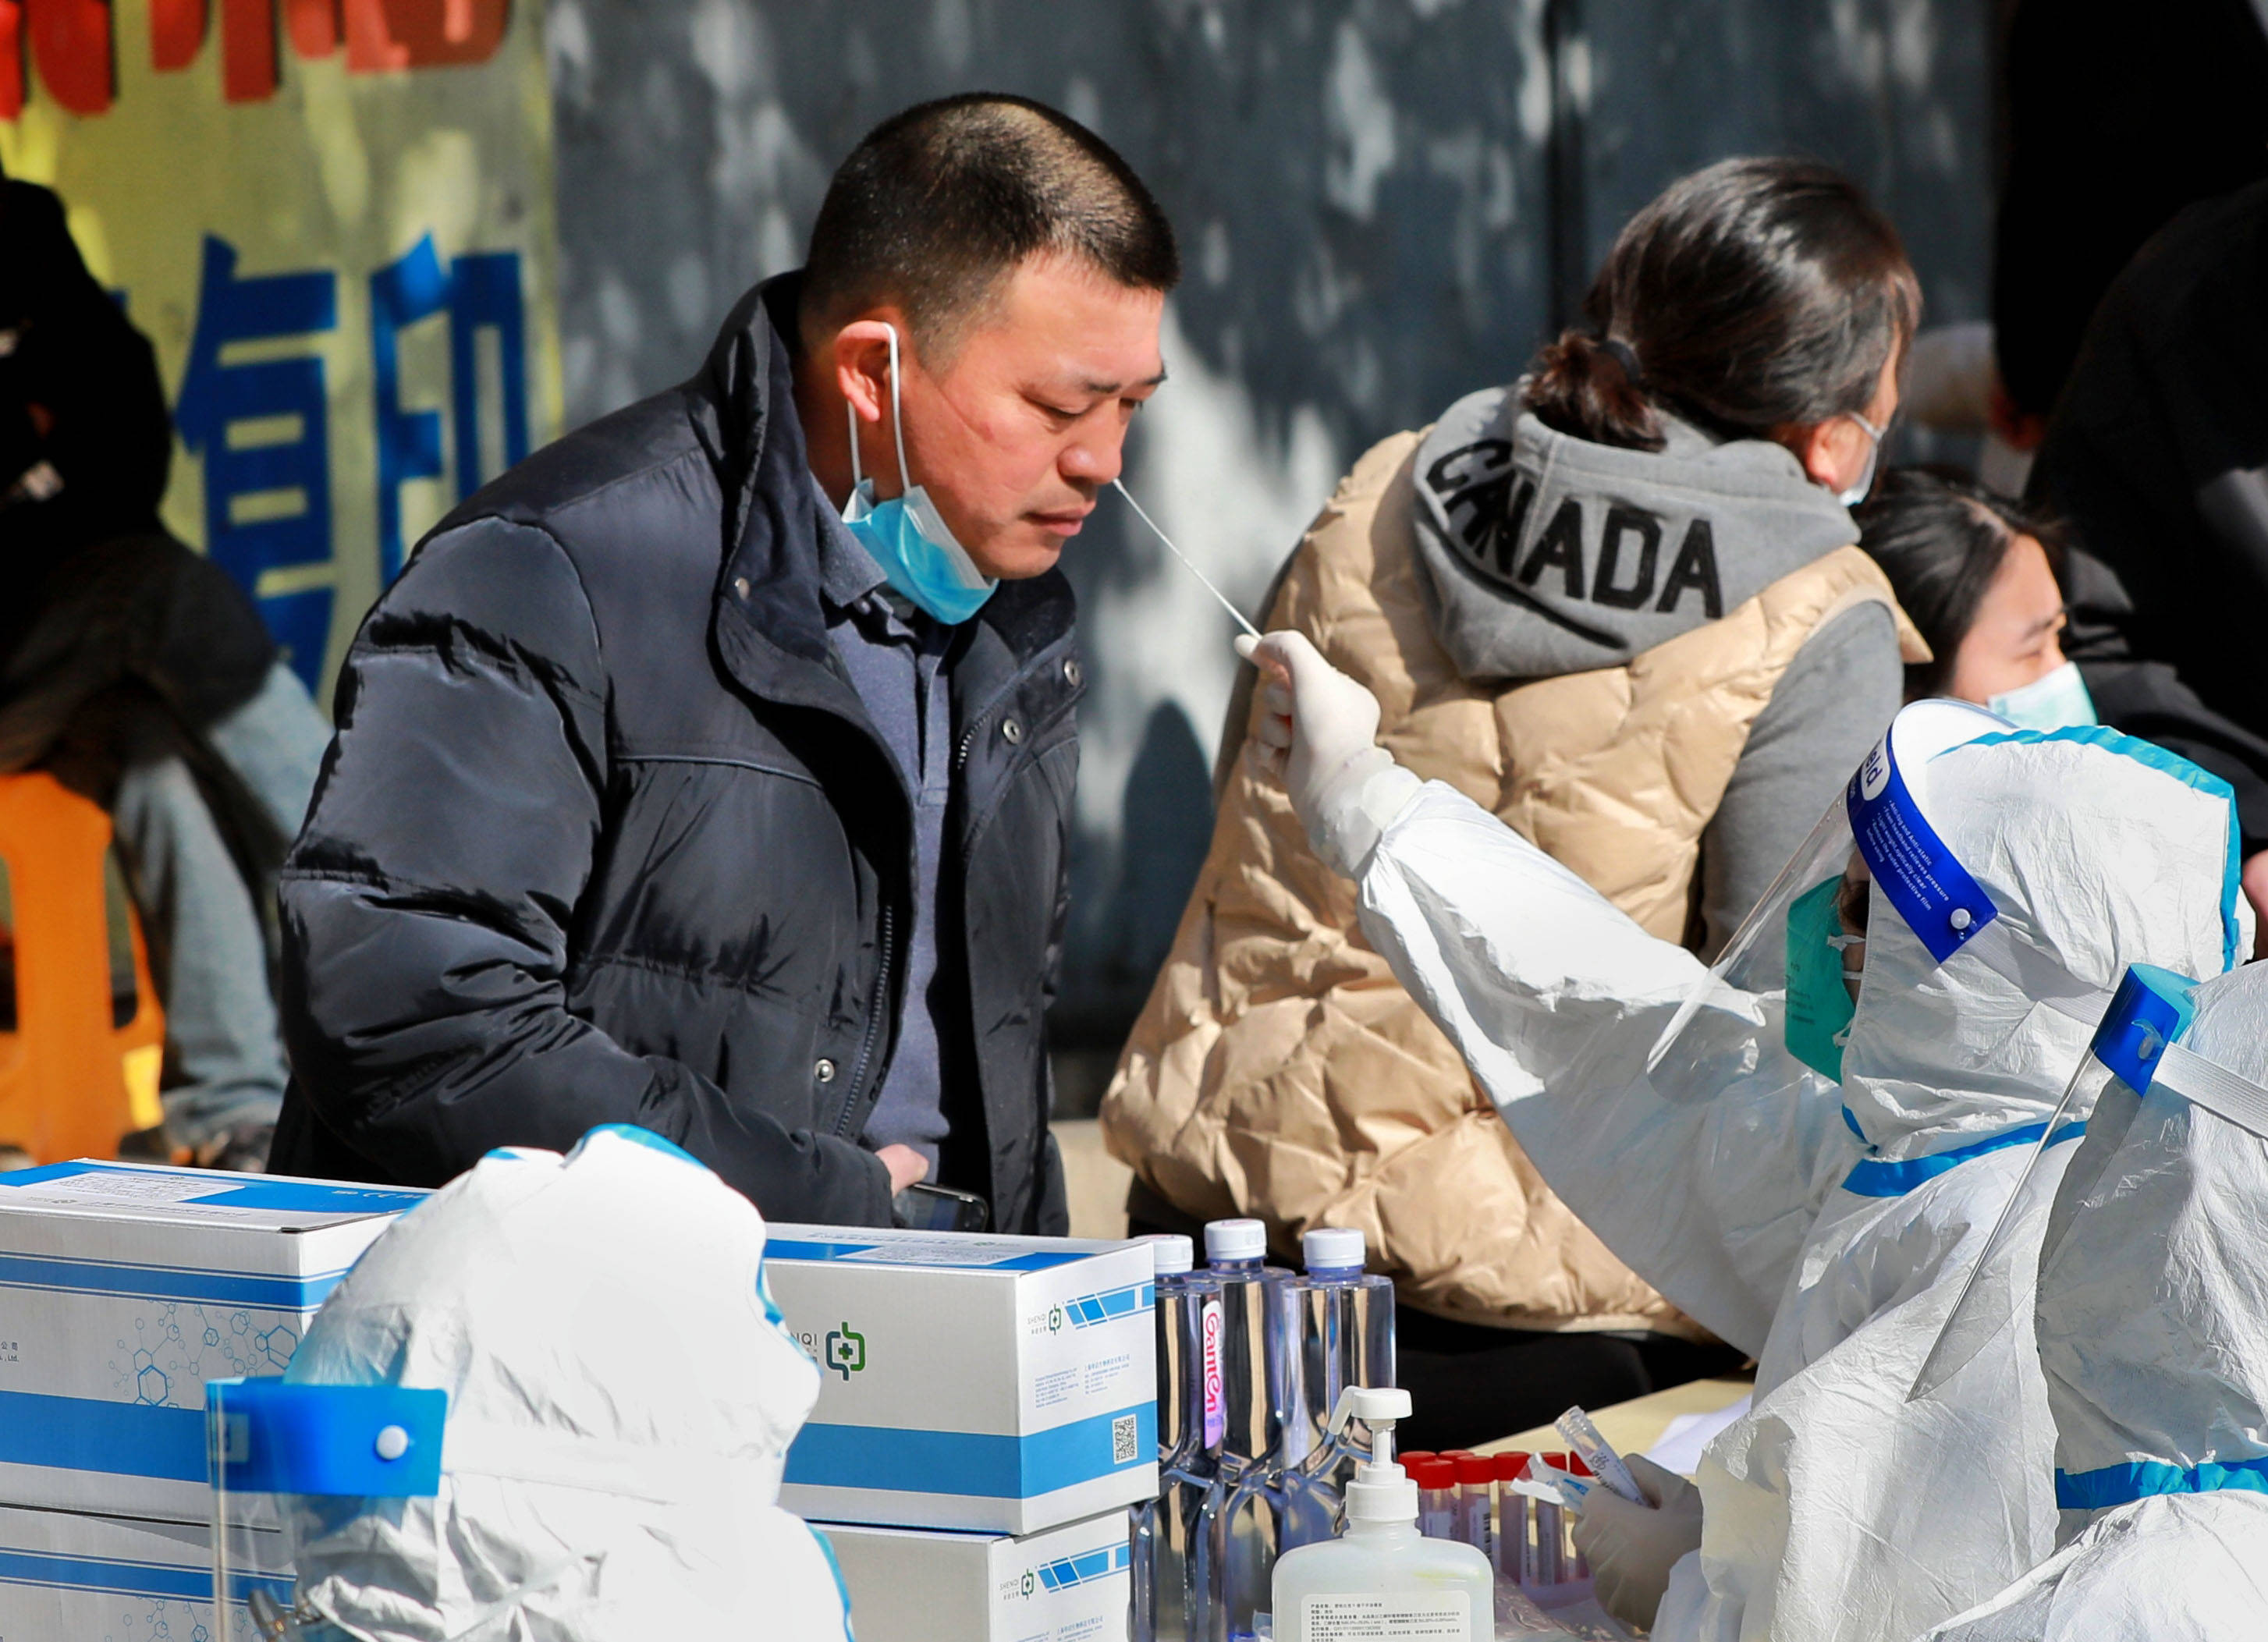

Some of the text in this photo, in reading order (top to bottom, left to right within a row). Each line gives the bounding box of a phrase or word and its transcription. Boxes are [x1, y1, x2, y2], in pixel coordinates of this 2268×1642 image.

[173, 228, 531, 704] 复印
[1891, 823, 1911, 852] headband
[1908, 850, 1927, 875] relieves
[1925, 873, 1950, 902] pressure
[1908, 834, 1933, 867] Anti-static
[1897, 867, 1922, 899] protective
[1920, 896, 1933, 912] film
[1912, 873, 1927, 890] clear
